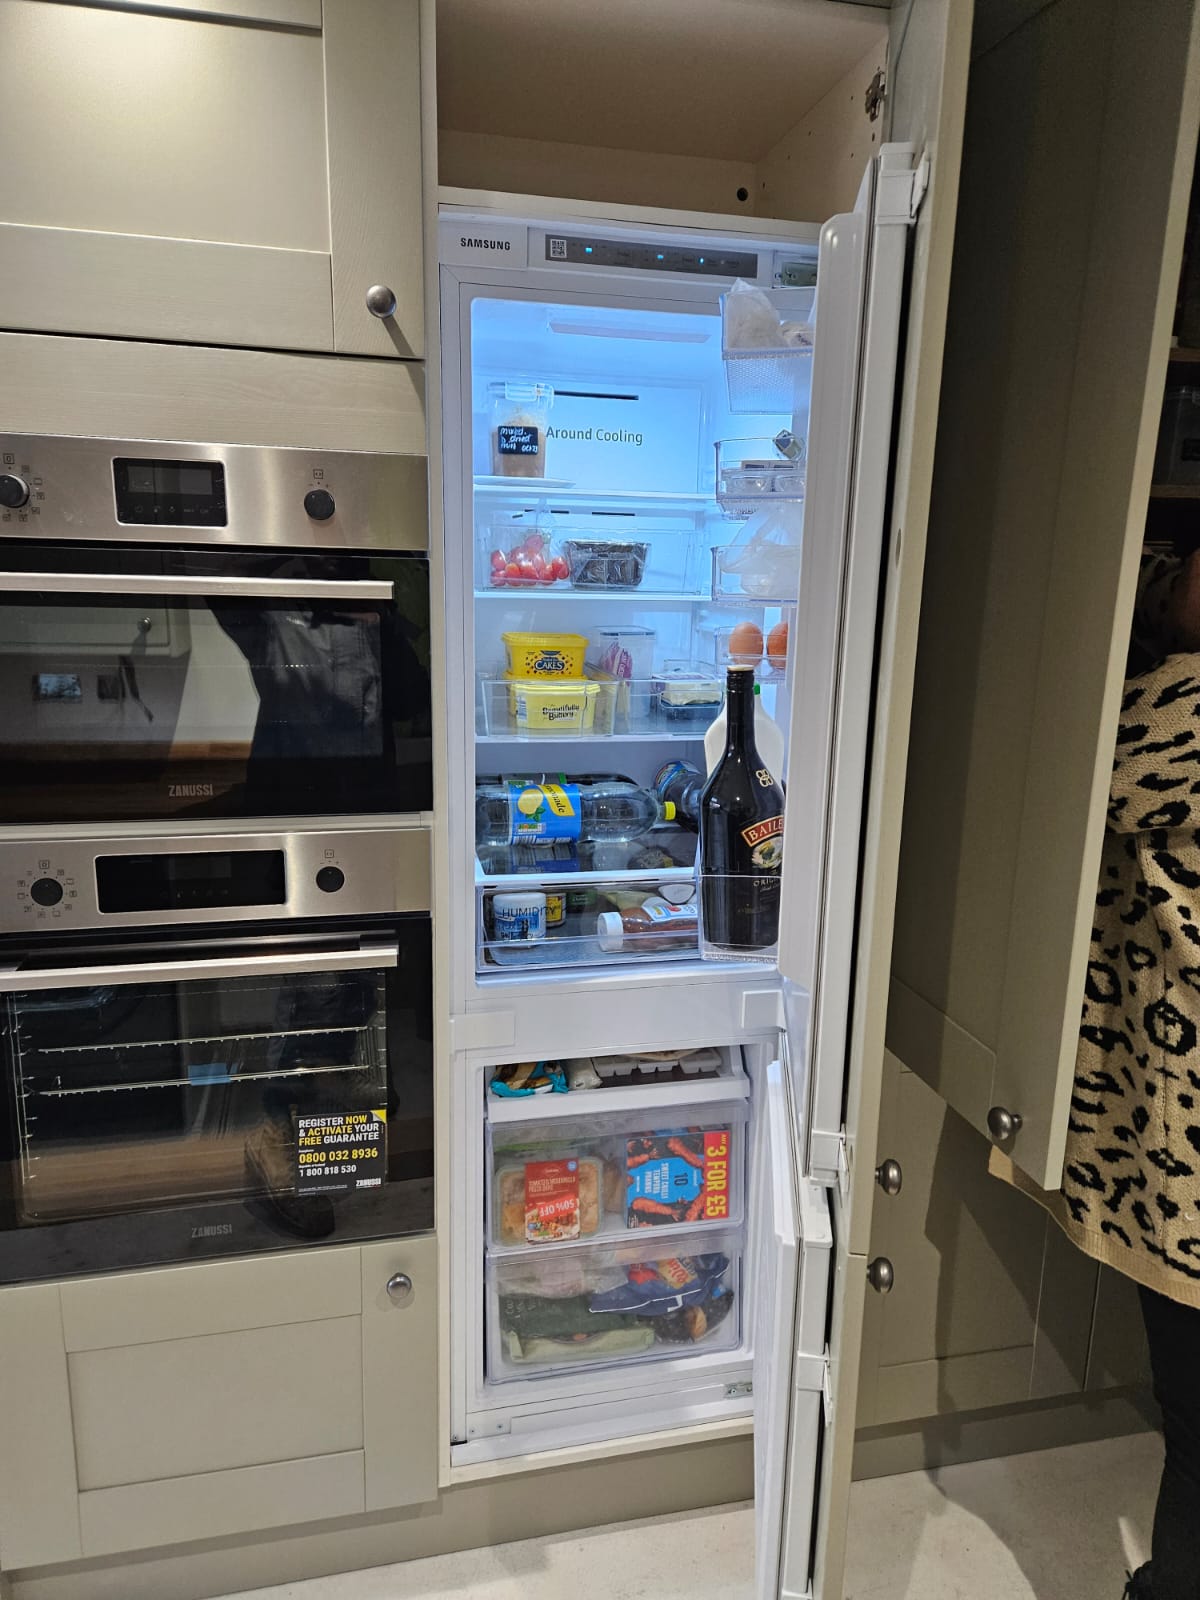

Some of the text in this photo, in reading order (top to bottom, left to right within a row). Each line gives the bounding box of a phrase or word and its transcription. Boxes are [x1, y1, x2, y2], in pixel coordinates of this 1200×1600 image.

[460, 237, 511, 251] SAMSUNG
[546, 426, 643, 446] Around Cooling
[535, 660, 563, 670] CAKES
[168, 784, 214, 797] ZANUSSI
[502, 906, 555, 918] HUMIDITY
[298, 1114, 367, 1129] REGISTER NOW
[299, 1129, 306, 1137] &
[307, 1125, 353, 1137] ACTIVATE
[354, 1123, 379, 1132] YOUR
[299, 1132, 380, 1146] FREE GUARANTEE
[299, 1152, 326, 1164] 0800
[329, 1150, 349, 1161] 032
[351, 1147, 378, 1159] 8936
[706, 1146, 727, 1157] 3
[300, 1169, 304, 1177] 1
[306, 1167, 322, 1176] 800
[324, 1166, 339, 1175] 818
[341, 1164, 357, 1174] 530
[706, 1160, 727, 1192] FOR
[356, 1178, 382, 1187] ZANUSSI
[674, 1172, 688, 1186] 10
[539, 1199, 575, 1217] 50% OFF
[706, 1195, 727, 1217] £5
[191, 1223, 233, 1239] ZANUSSI
